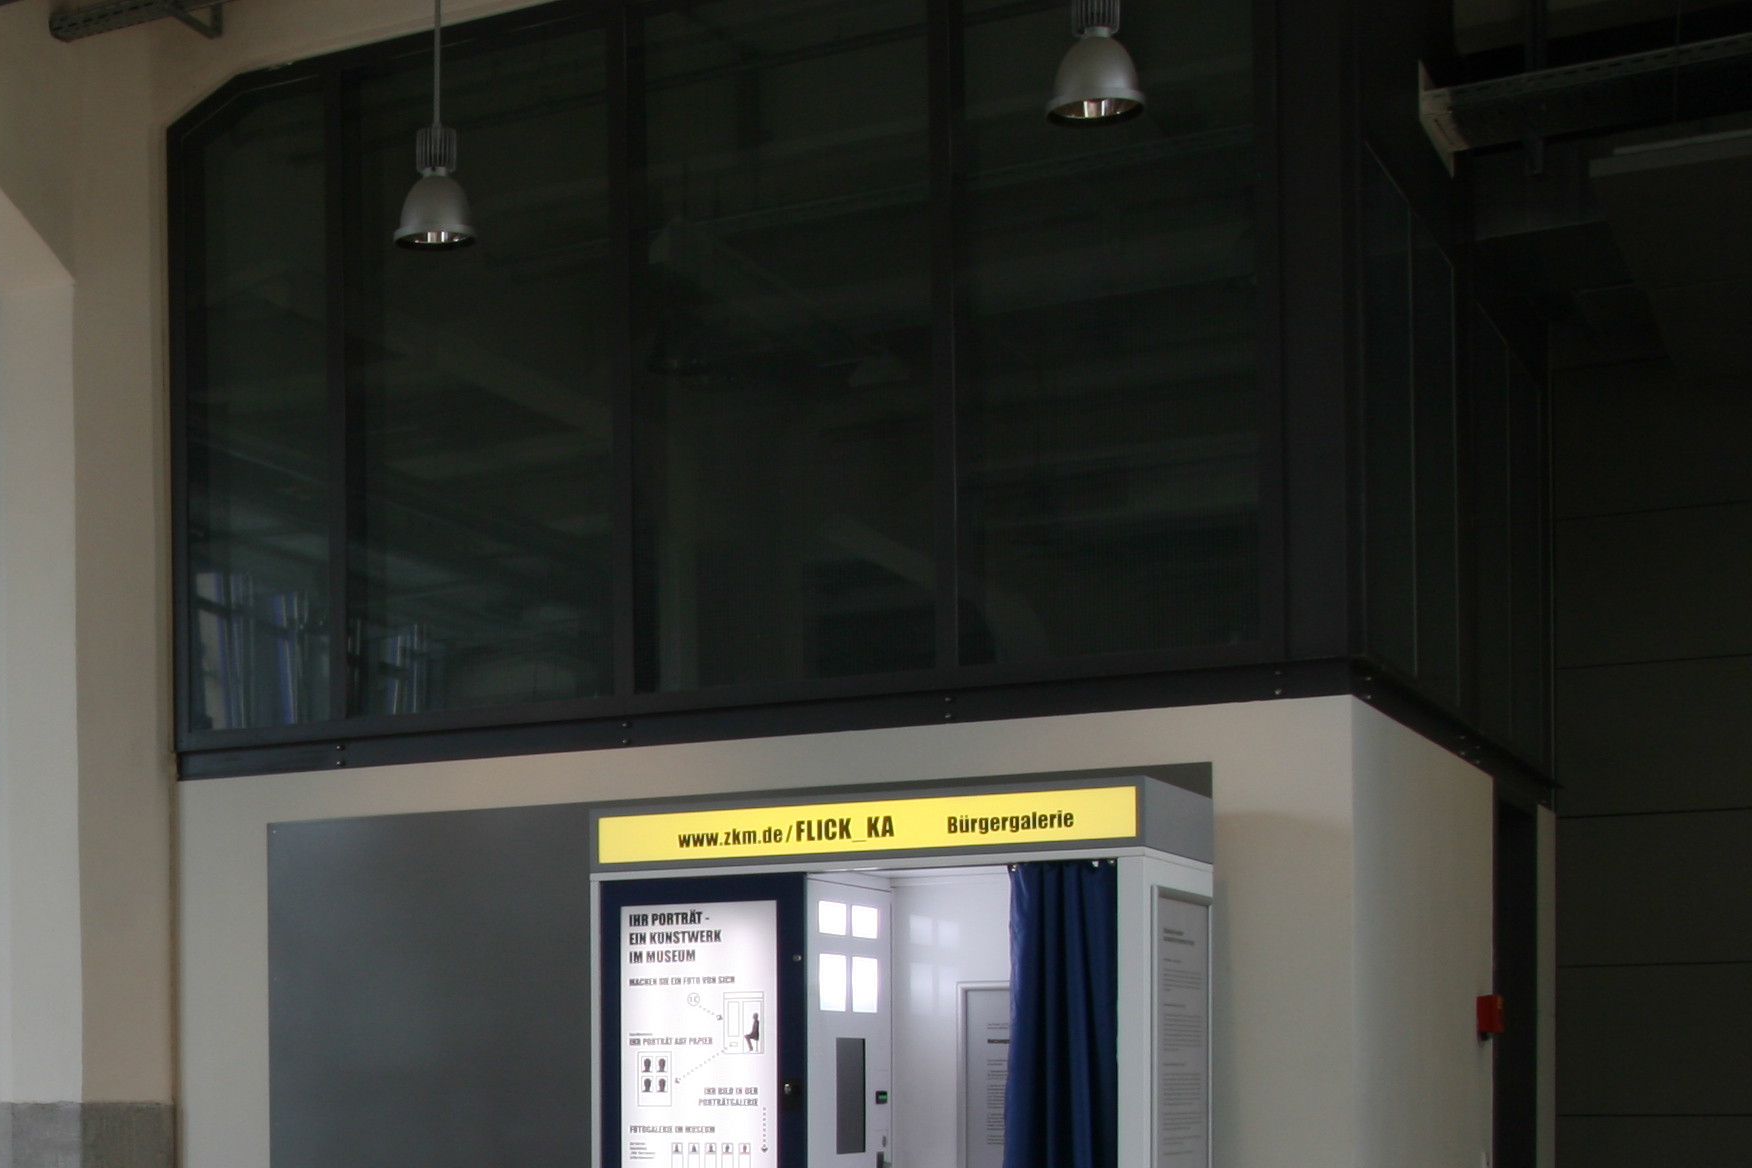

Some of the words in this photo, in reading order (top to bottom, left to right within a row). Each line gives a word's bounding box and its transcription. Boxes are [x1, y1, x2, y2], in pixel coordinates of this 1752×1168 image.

[947, 810, 1074, 834] Bürgergalerie
[629, 914, 648, 927] IHR
[651, 909, 703, 926] PORTRÄT
[629, 933, 647, 945] EIN
[649, 929, 722, 945] KUNSTWERK
[629, 950, 643, 964] IM
[646, 949, 696, 963] MUSEUM
[683, 976, 701, 985] FOTO
